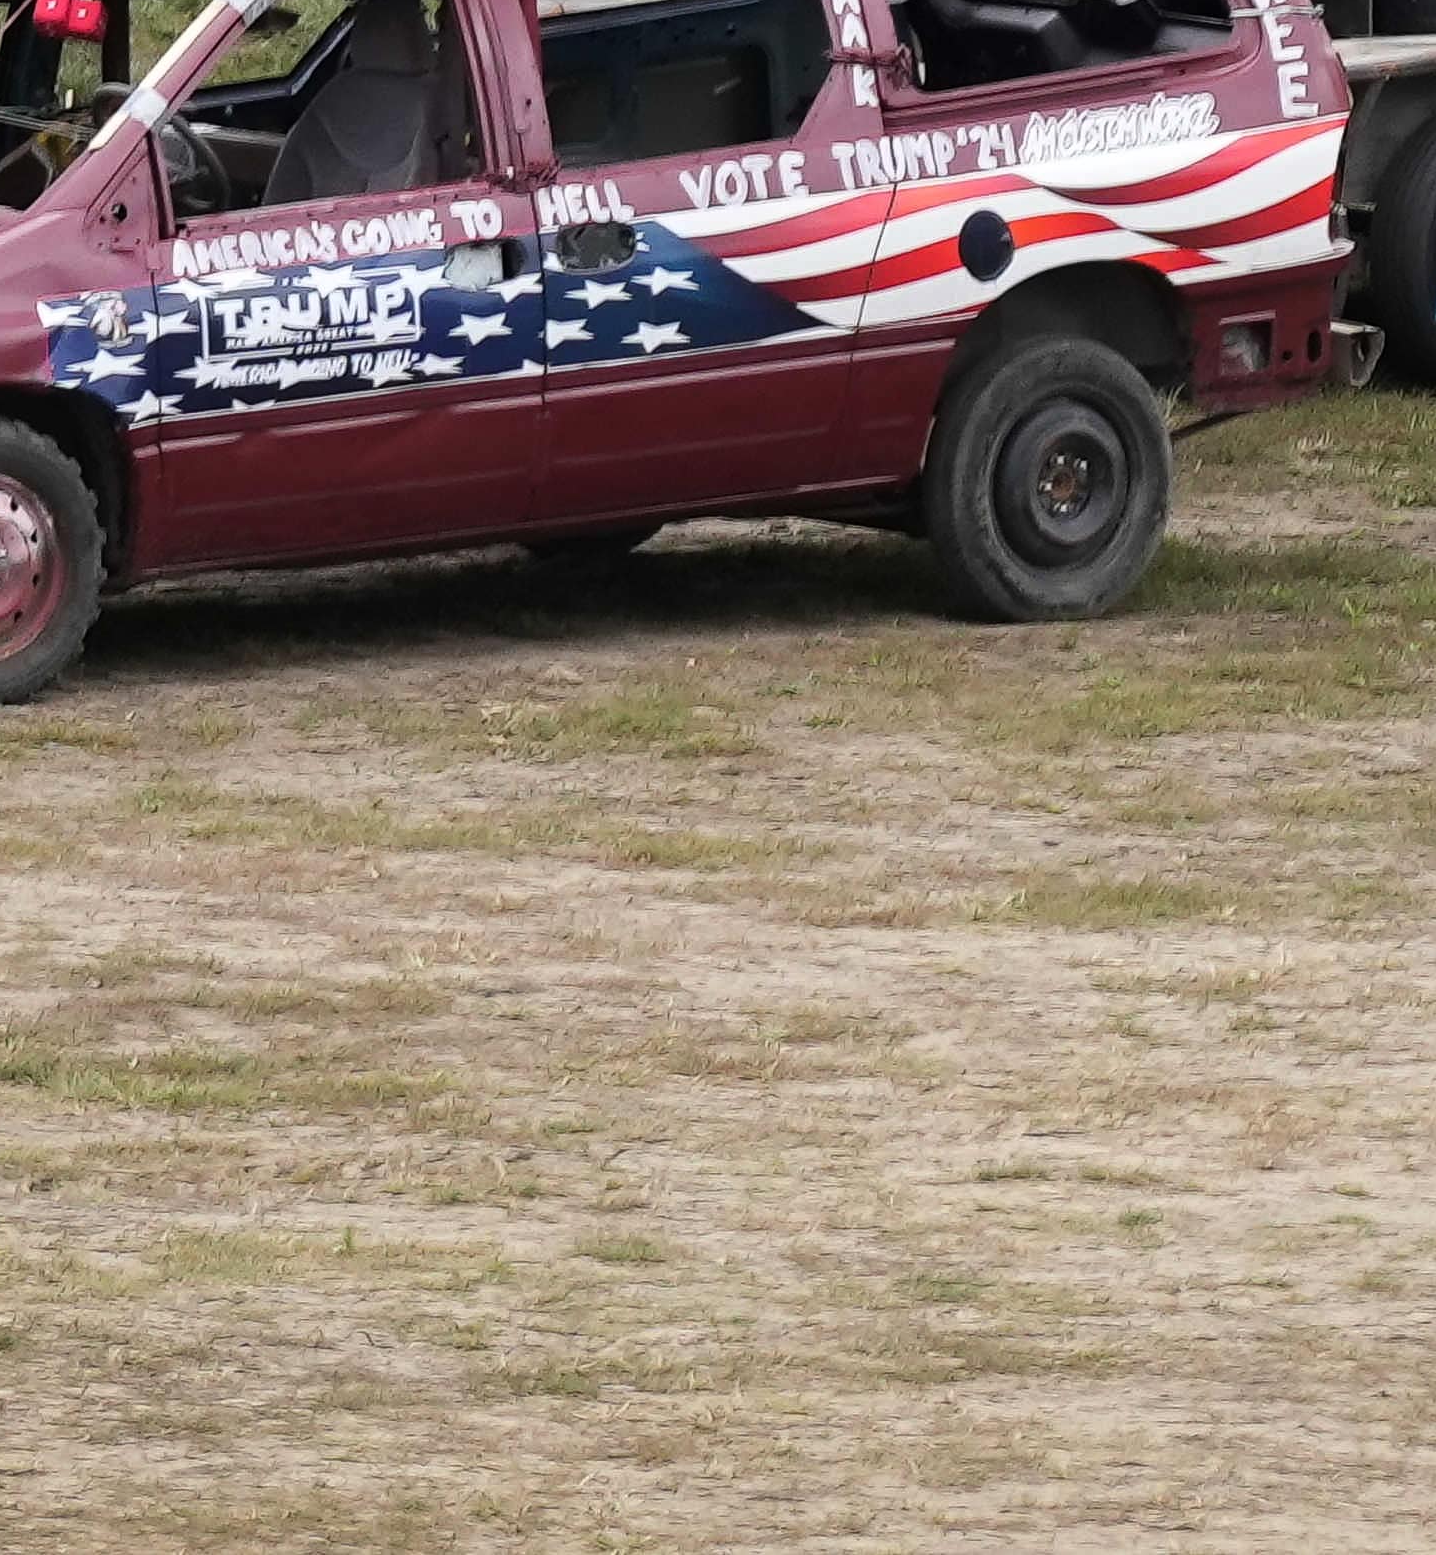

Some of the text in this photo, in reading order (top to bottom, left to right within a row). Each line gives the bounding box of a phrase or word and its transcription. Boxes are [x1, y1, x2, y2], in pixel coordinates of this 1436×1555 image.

[679, 151, 809, 210] VOTE
[832, 130, 955, 188] TRUMP
[171, 180, 636, 278] AMERICA'S GOING TO HELL
[213, 282, 406, 339] TRUMP
